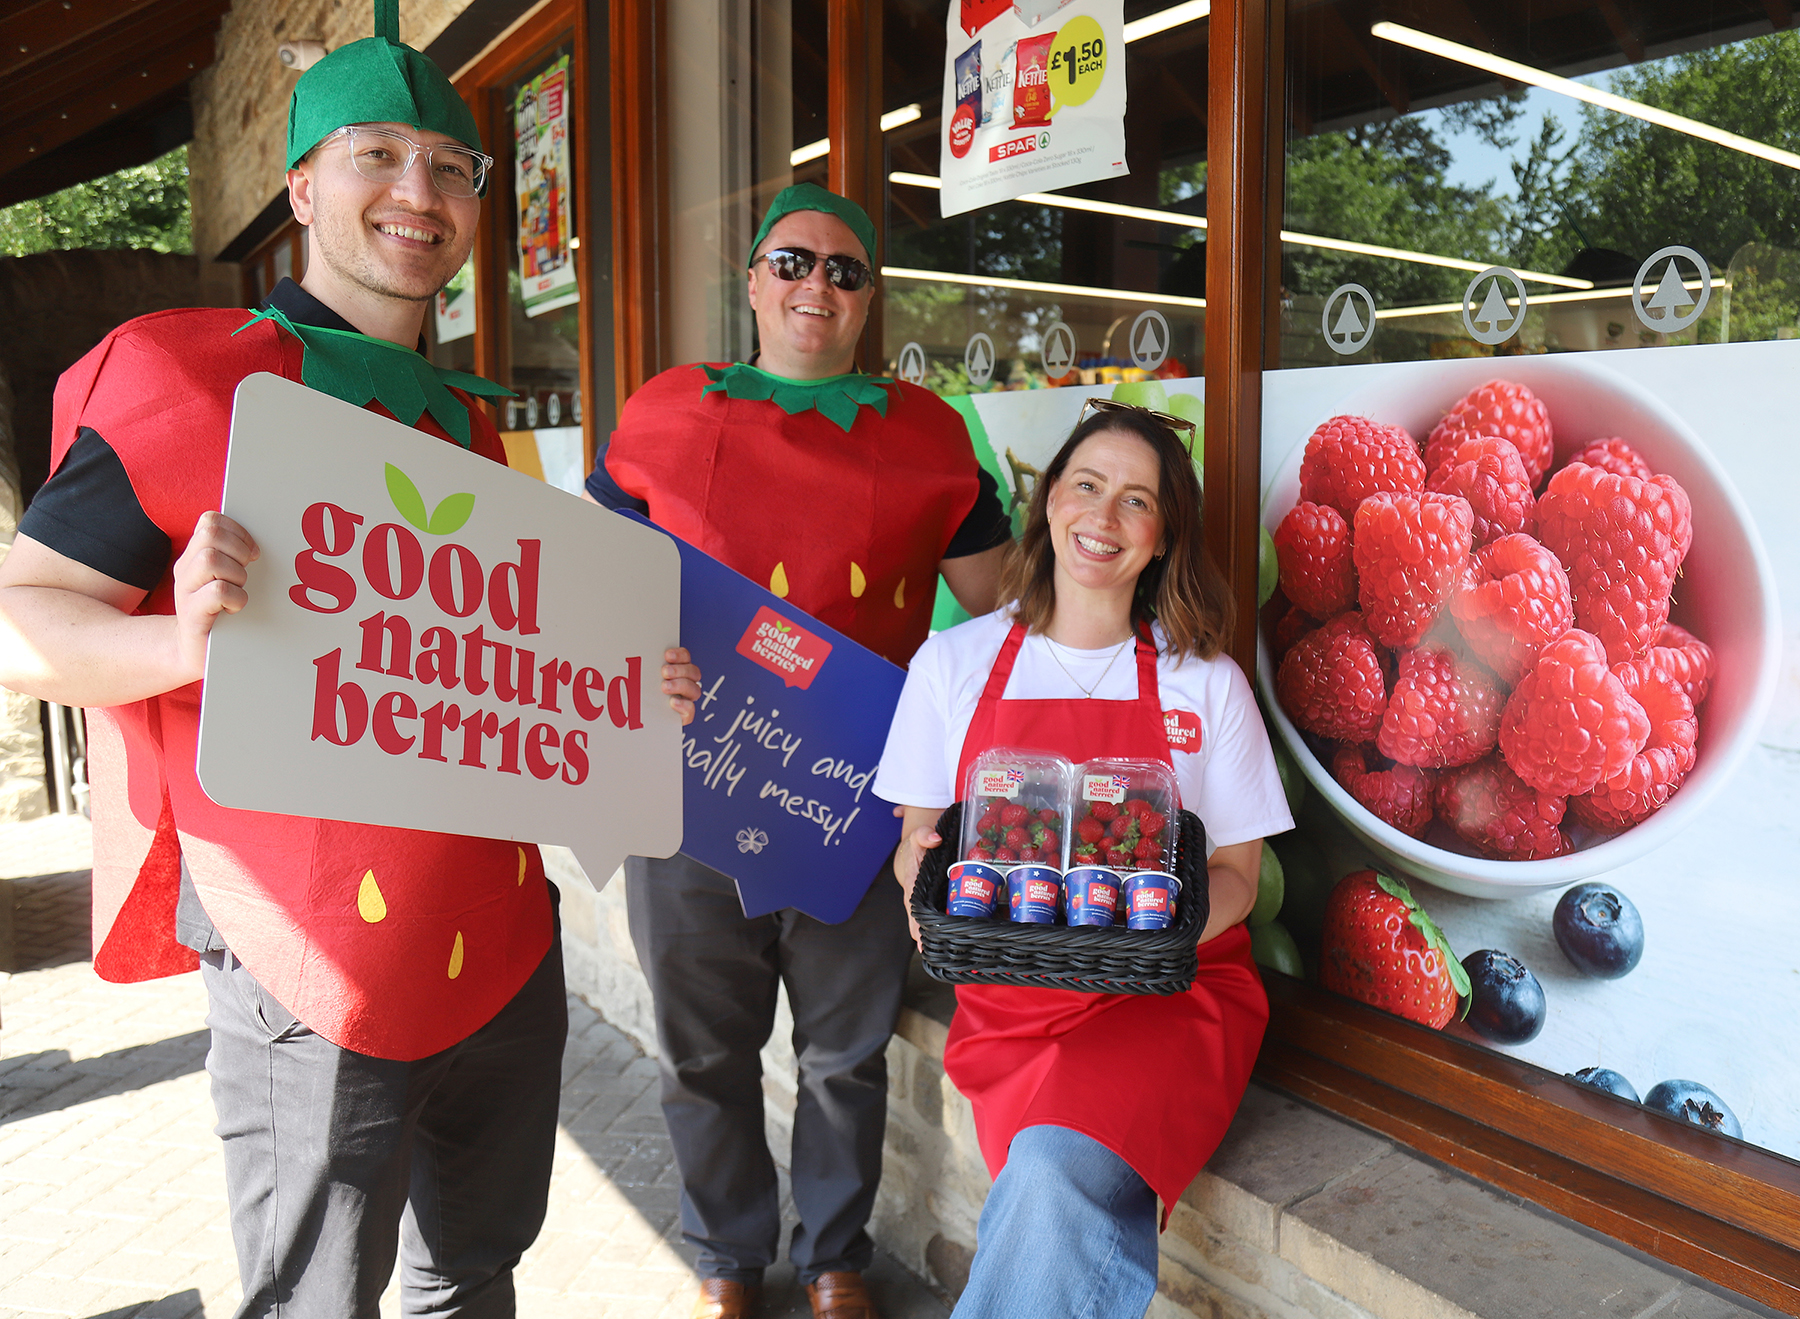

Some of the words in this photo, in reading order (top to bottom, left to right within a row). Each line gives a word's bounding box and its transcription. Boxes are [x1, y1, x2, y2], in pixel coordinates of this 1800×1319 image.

[1051, 38, 1103, 85] £1.50
[1079, 60, 1102, 75] EACH
[1017, 69, 1048, 88] KETTLE
[997, 137, 1036, 158] SPAR
[288, 501, 541, 635] good
[756, 622, 801, 650] good
[751, 640, 797, 673] berries
[761, 637, 815, 670] natured
[355, 610, 644, 730] natured
[311, 647, 590, 786] berries
[1163, 714, 1179, 727] od
[1166, 726, 1196, 738] tured
[1167, 735, 1187, 745] ries
[714, 695, 802, 768] juicy
[811, 757, 878, 803] and
[983, 775, 1004, 784] good
[987, 781, 1015, 789] natured
[1088, 780, 1109, 789] good
[682, 732, 747, 797] nally
[759, 780, 861, 847] messy!
[984, 785, 1009, 793] berries
[1089, 790, 1114, 798] berries
[1092, 786, 1120, 794] natured
[964, 880, 983, 888] good
[1029, 884, 1048, 892] good
[1135, 890, 1154, 902] good
